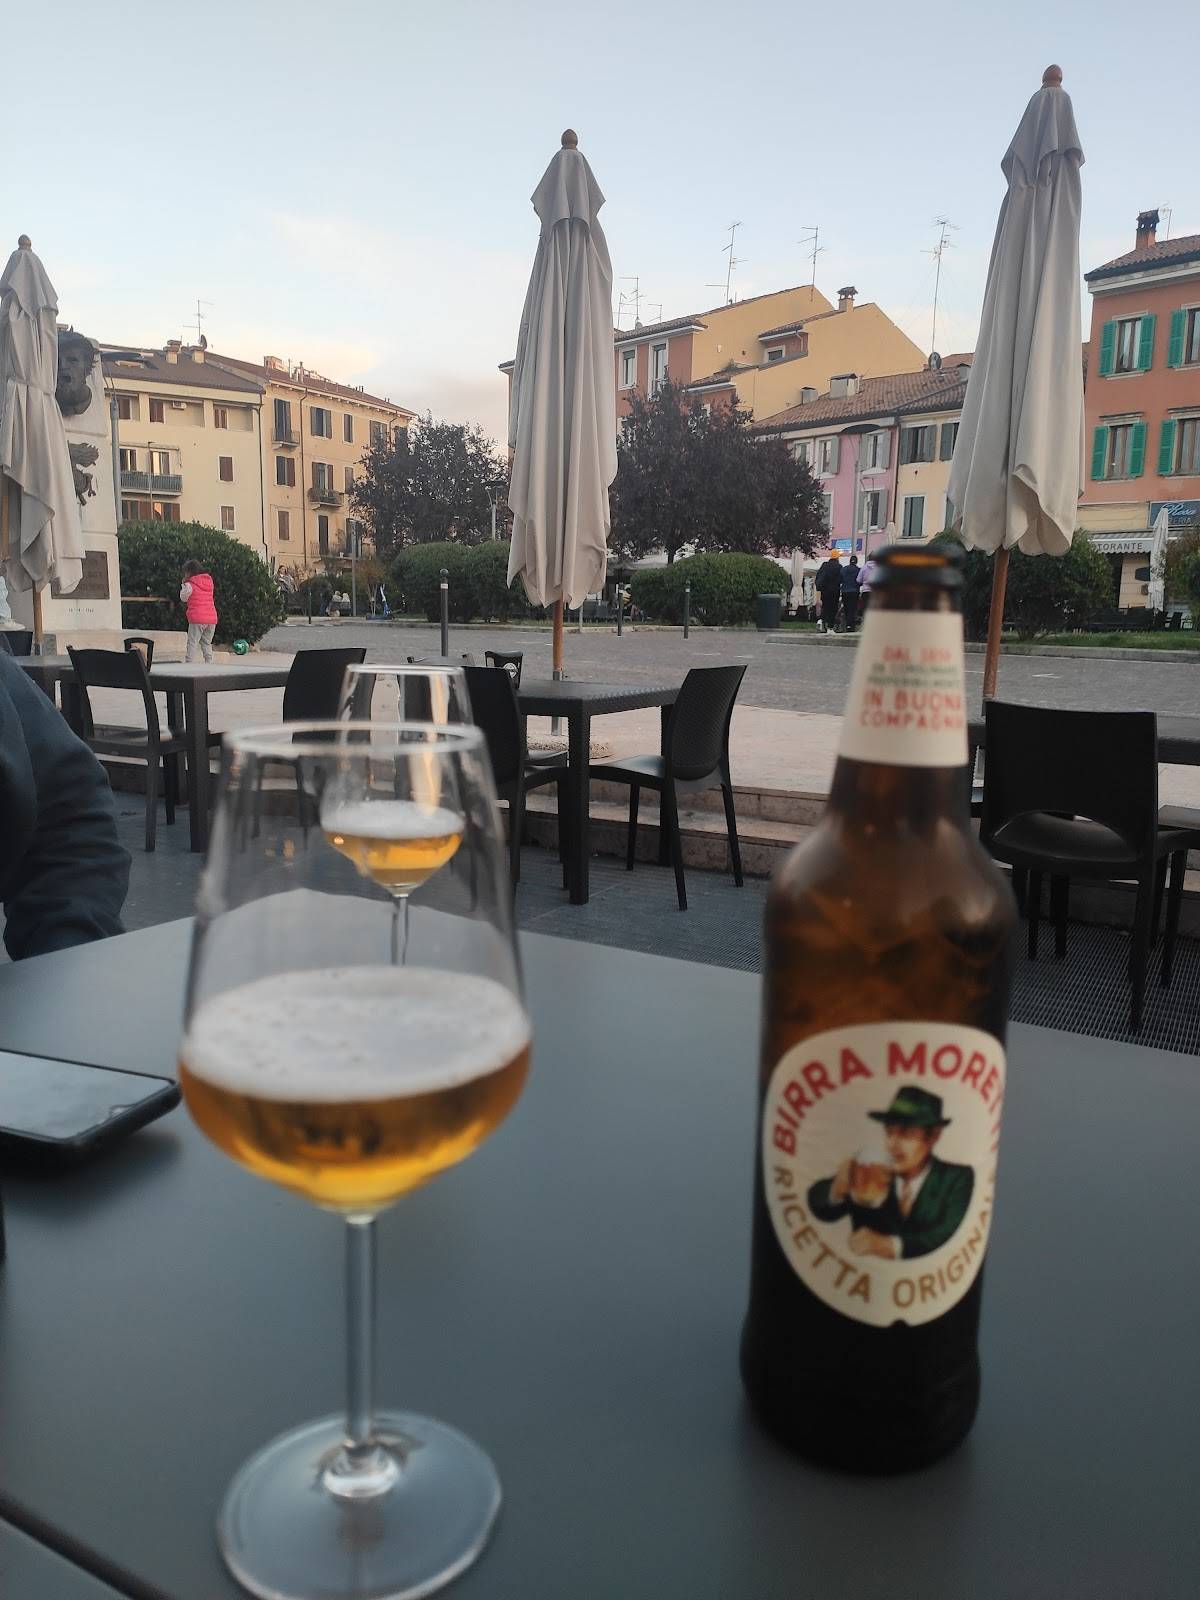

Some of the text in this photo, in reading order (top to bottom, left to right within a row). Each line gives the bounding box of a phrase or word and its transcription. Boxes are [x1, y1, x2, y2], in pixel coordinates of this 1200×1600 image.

[860, 710, 963, 730] COMPAGN
[773, 1047, 872, 1156] BIRRA
[774, 1166, 872, 1303] RICETTA
